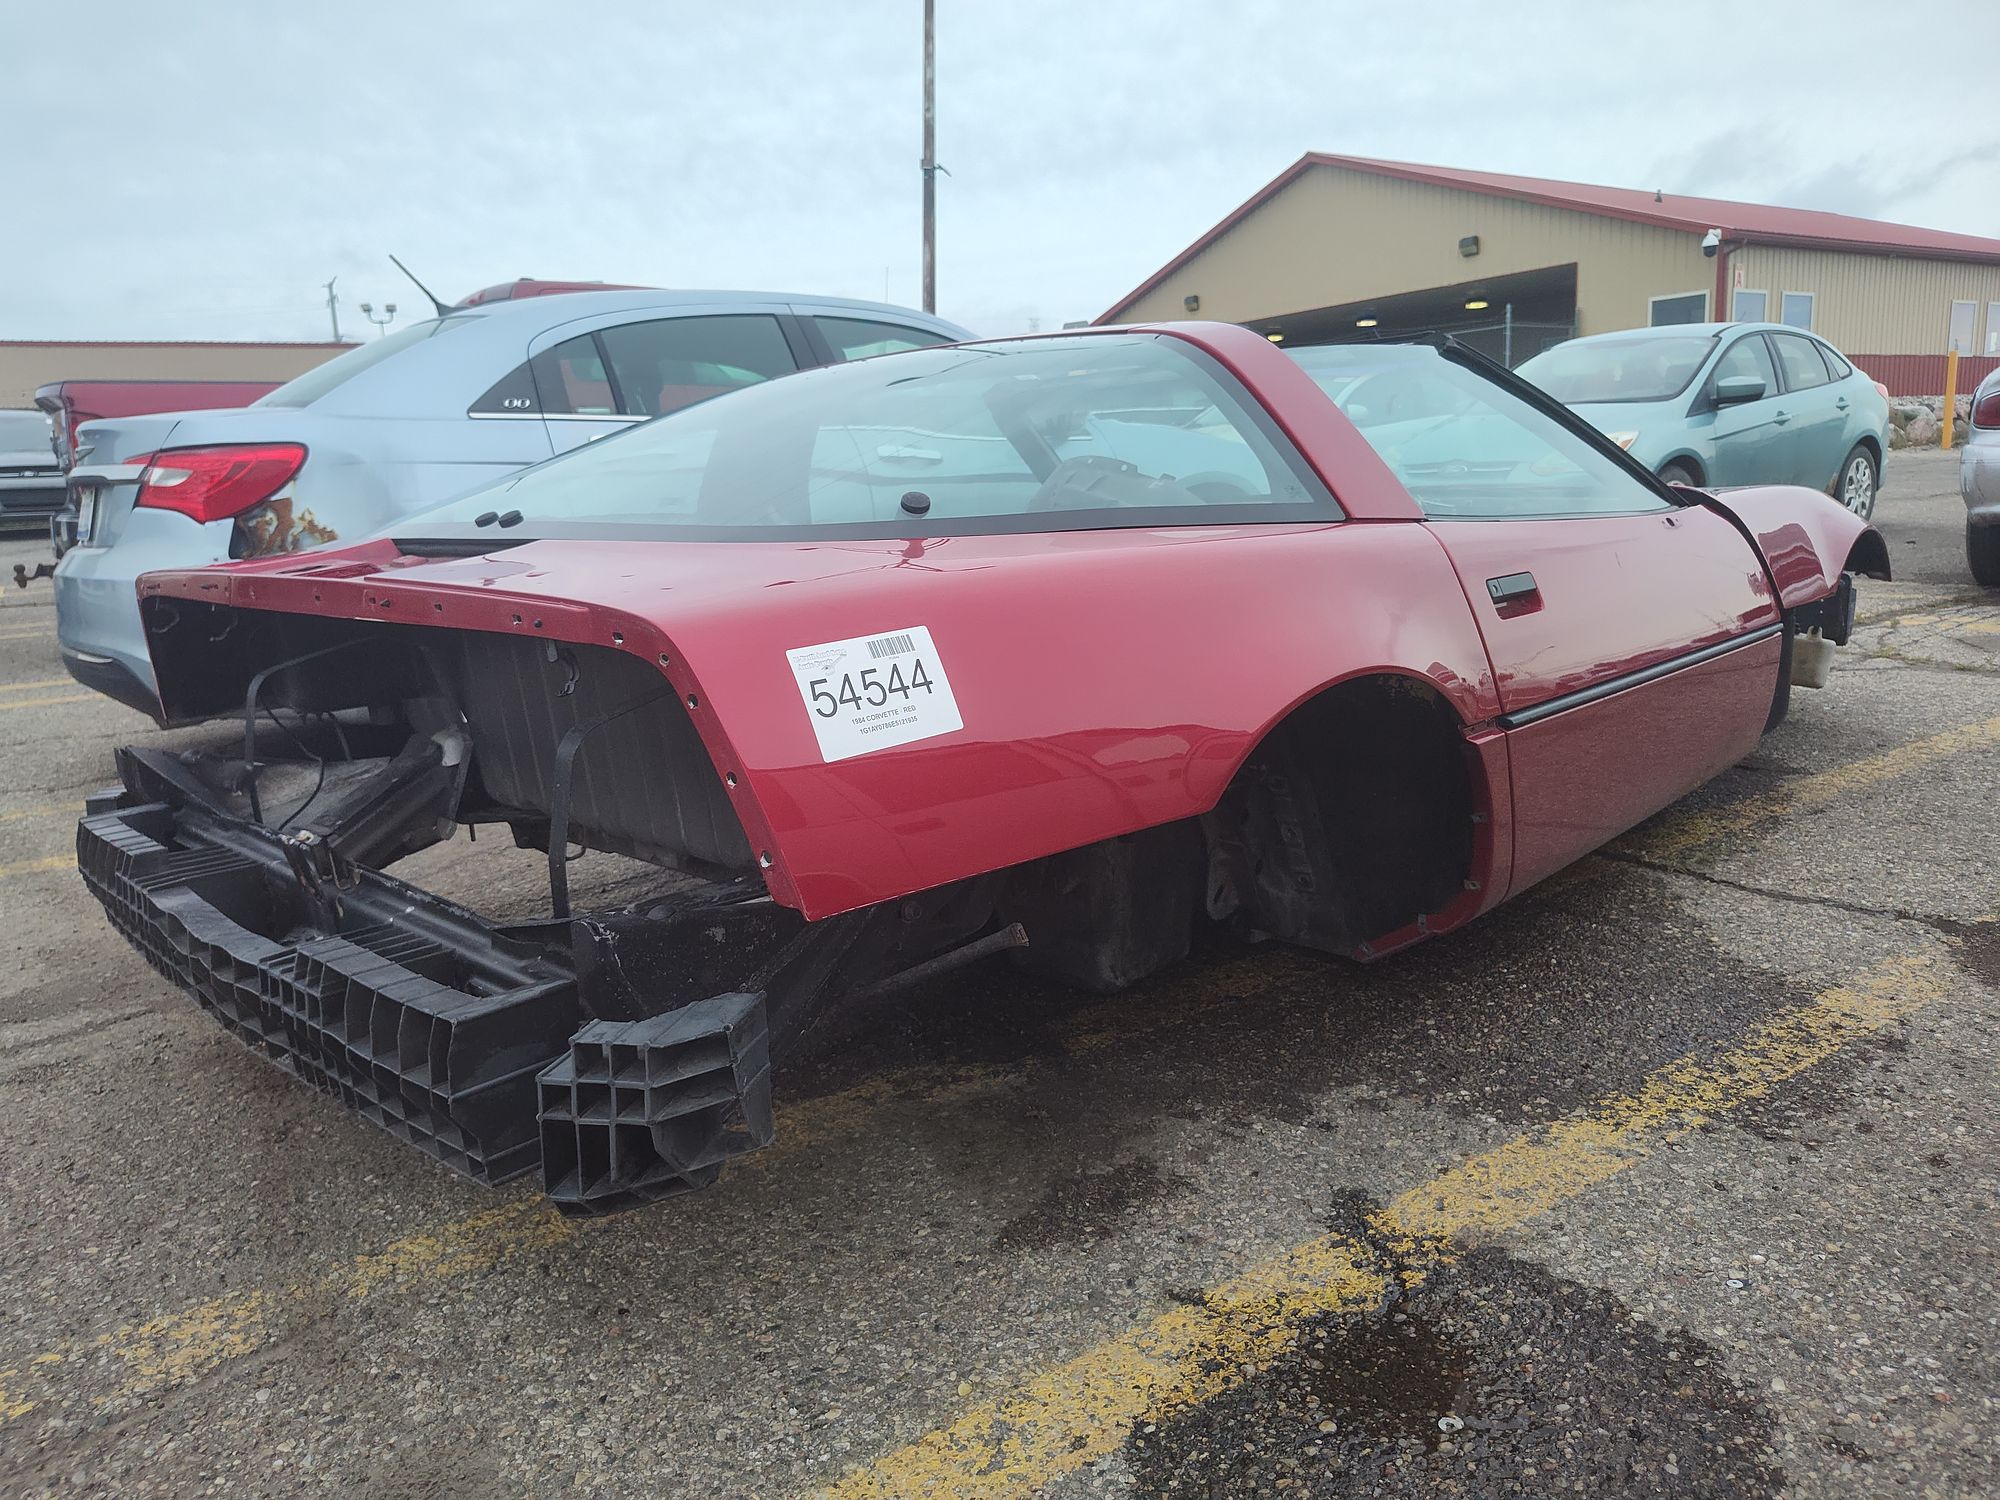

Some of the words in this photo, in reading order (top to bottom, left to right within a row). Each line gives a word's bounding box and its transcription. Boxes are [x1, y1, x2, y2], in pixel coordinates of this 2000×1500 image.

[809, 658, 934, 718] 54544
[851, 716, 866, 726] 1984
[866, 708, 900, 722] CORVETTE
[903, 704, 917, 714] RED
